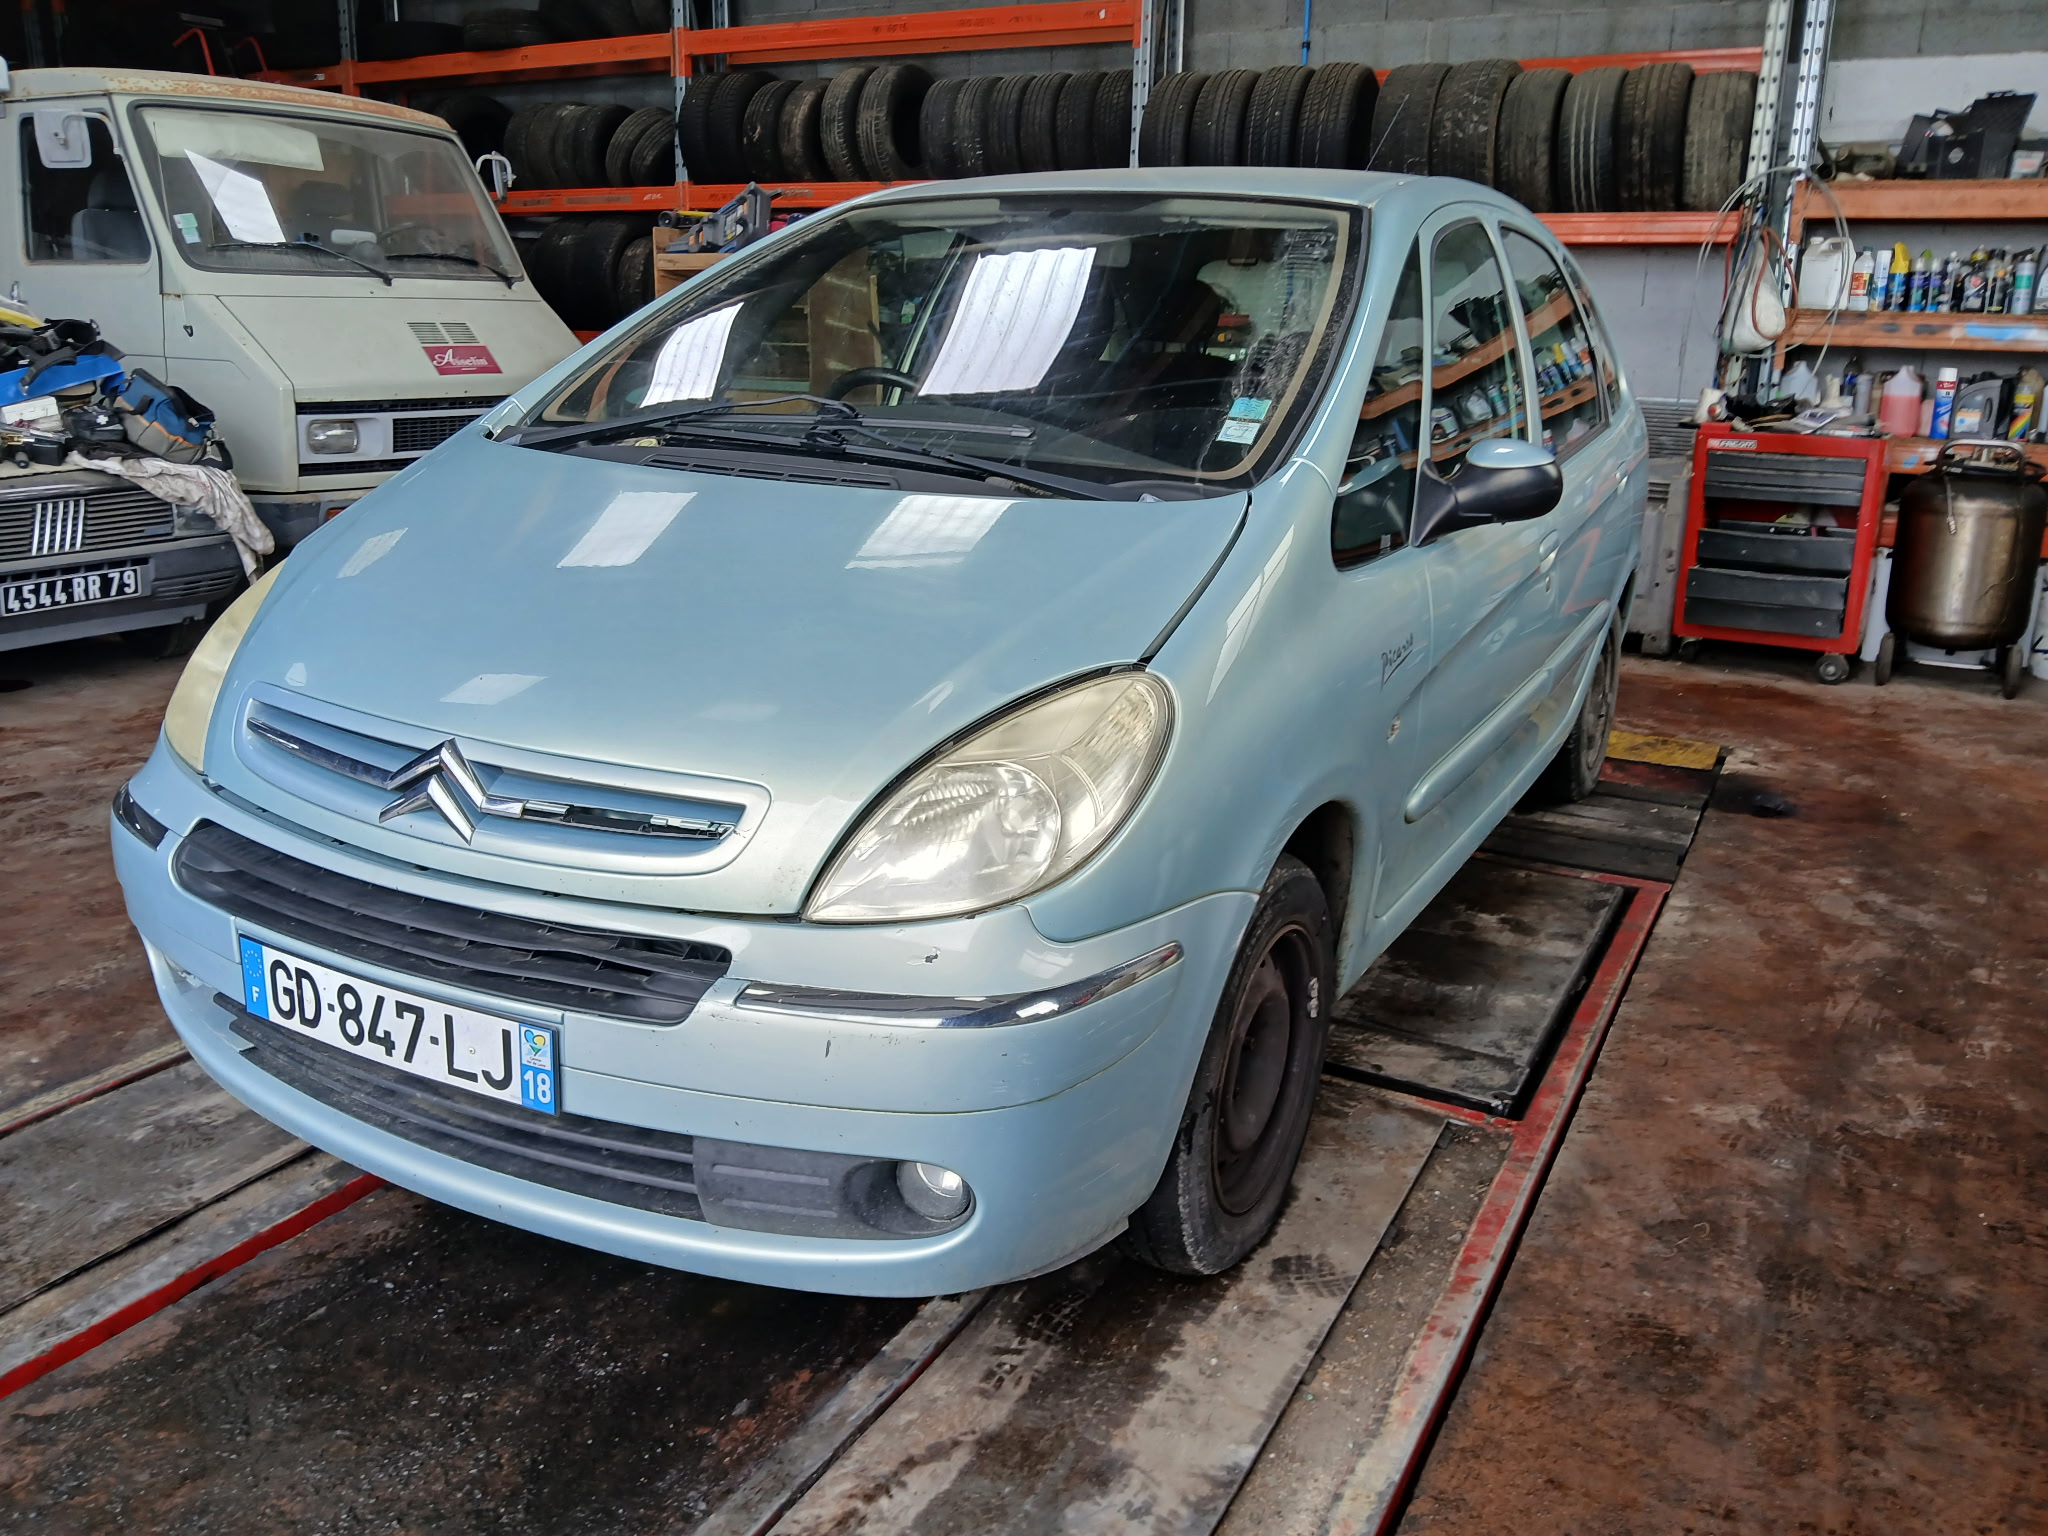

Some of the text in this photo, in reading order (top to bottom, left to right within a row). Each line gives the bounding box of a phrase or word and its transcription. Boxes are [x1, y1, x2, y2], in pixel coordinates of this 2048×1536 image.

[7, 570, 137, 612] 4544 RR 79
[251, 986, 260, 1003] F
[269, 959, 513, 1091] GD-847-LJ
[523, 1069, 552, 1104] 18
